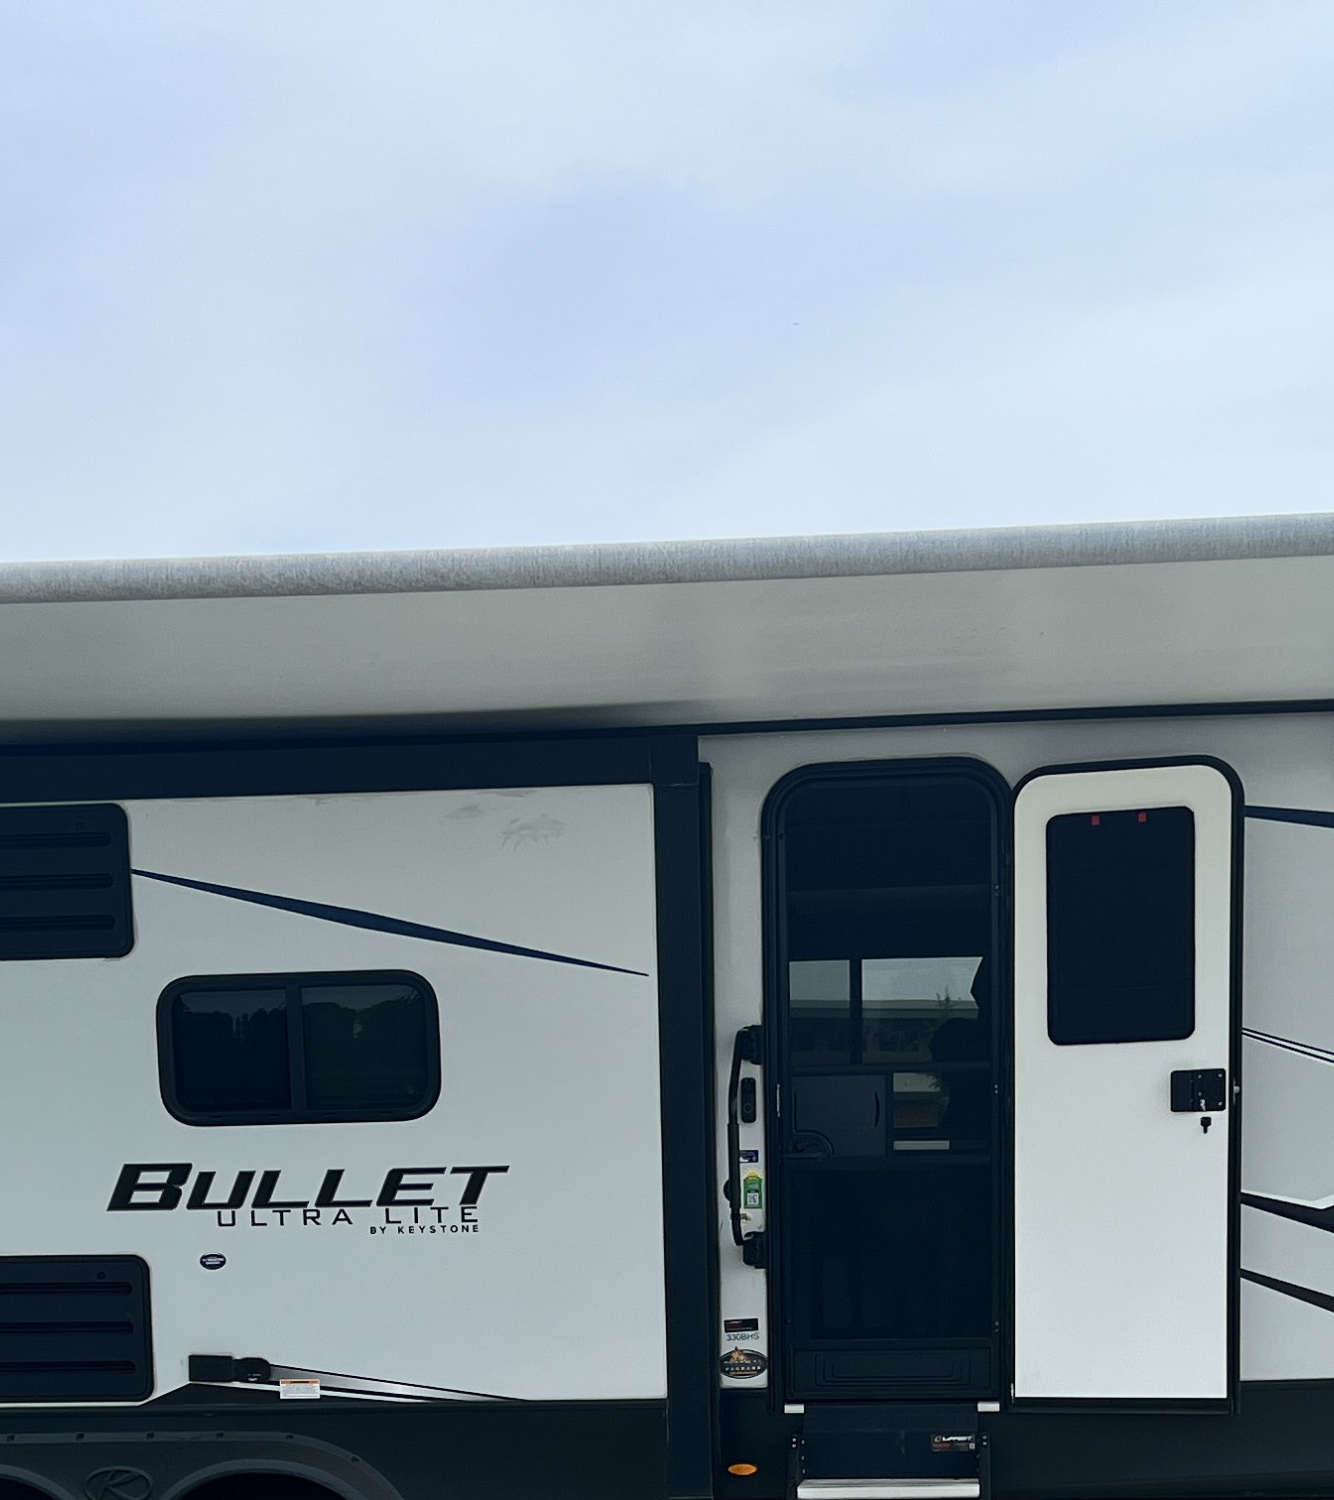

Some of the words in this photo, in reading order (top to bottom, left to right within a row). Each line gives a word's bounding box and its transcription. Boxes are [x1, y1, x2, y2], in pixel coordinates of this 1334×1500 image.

[106, 1163, 510, 1211] BULLET
[217, 1208, 354, 1227] ULTRA
[384, 1206, 479, 1224] LITE
[369, 1226, 387, 1235] BY
[397, 1224, 480, 1235] KEYSTONE
